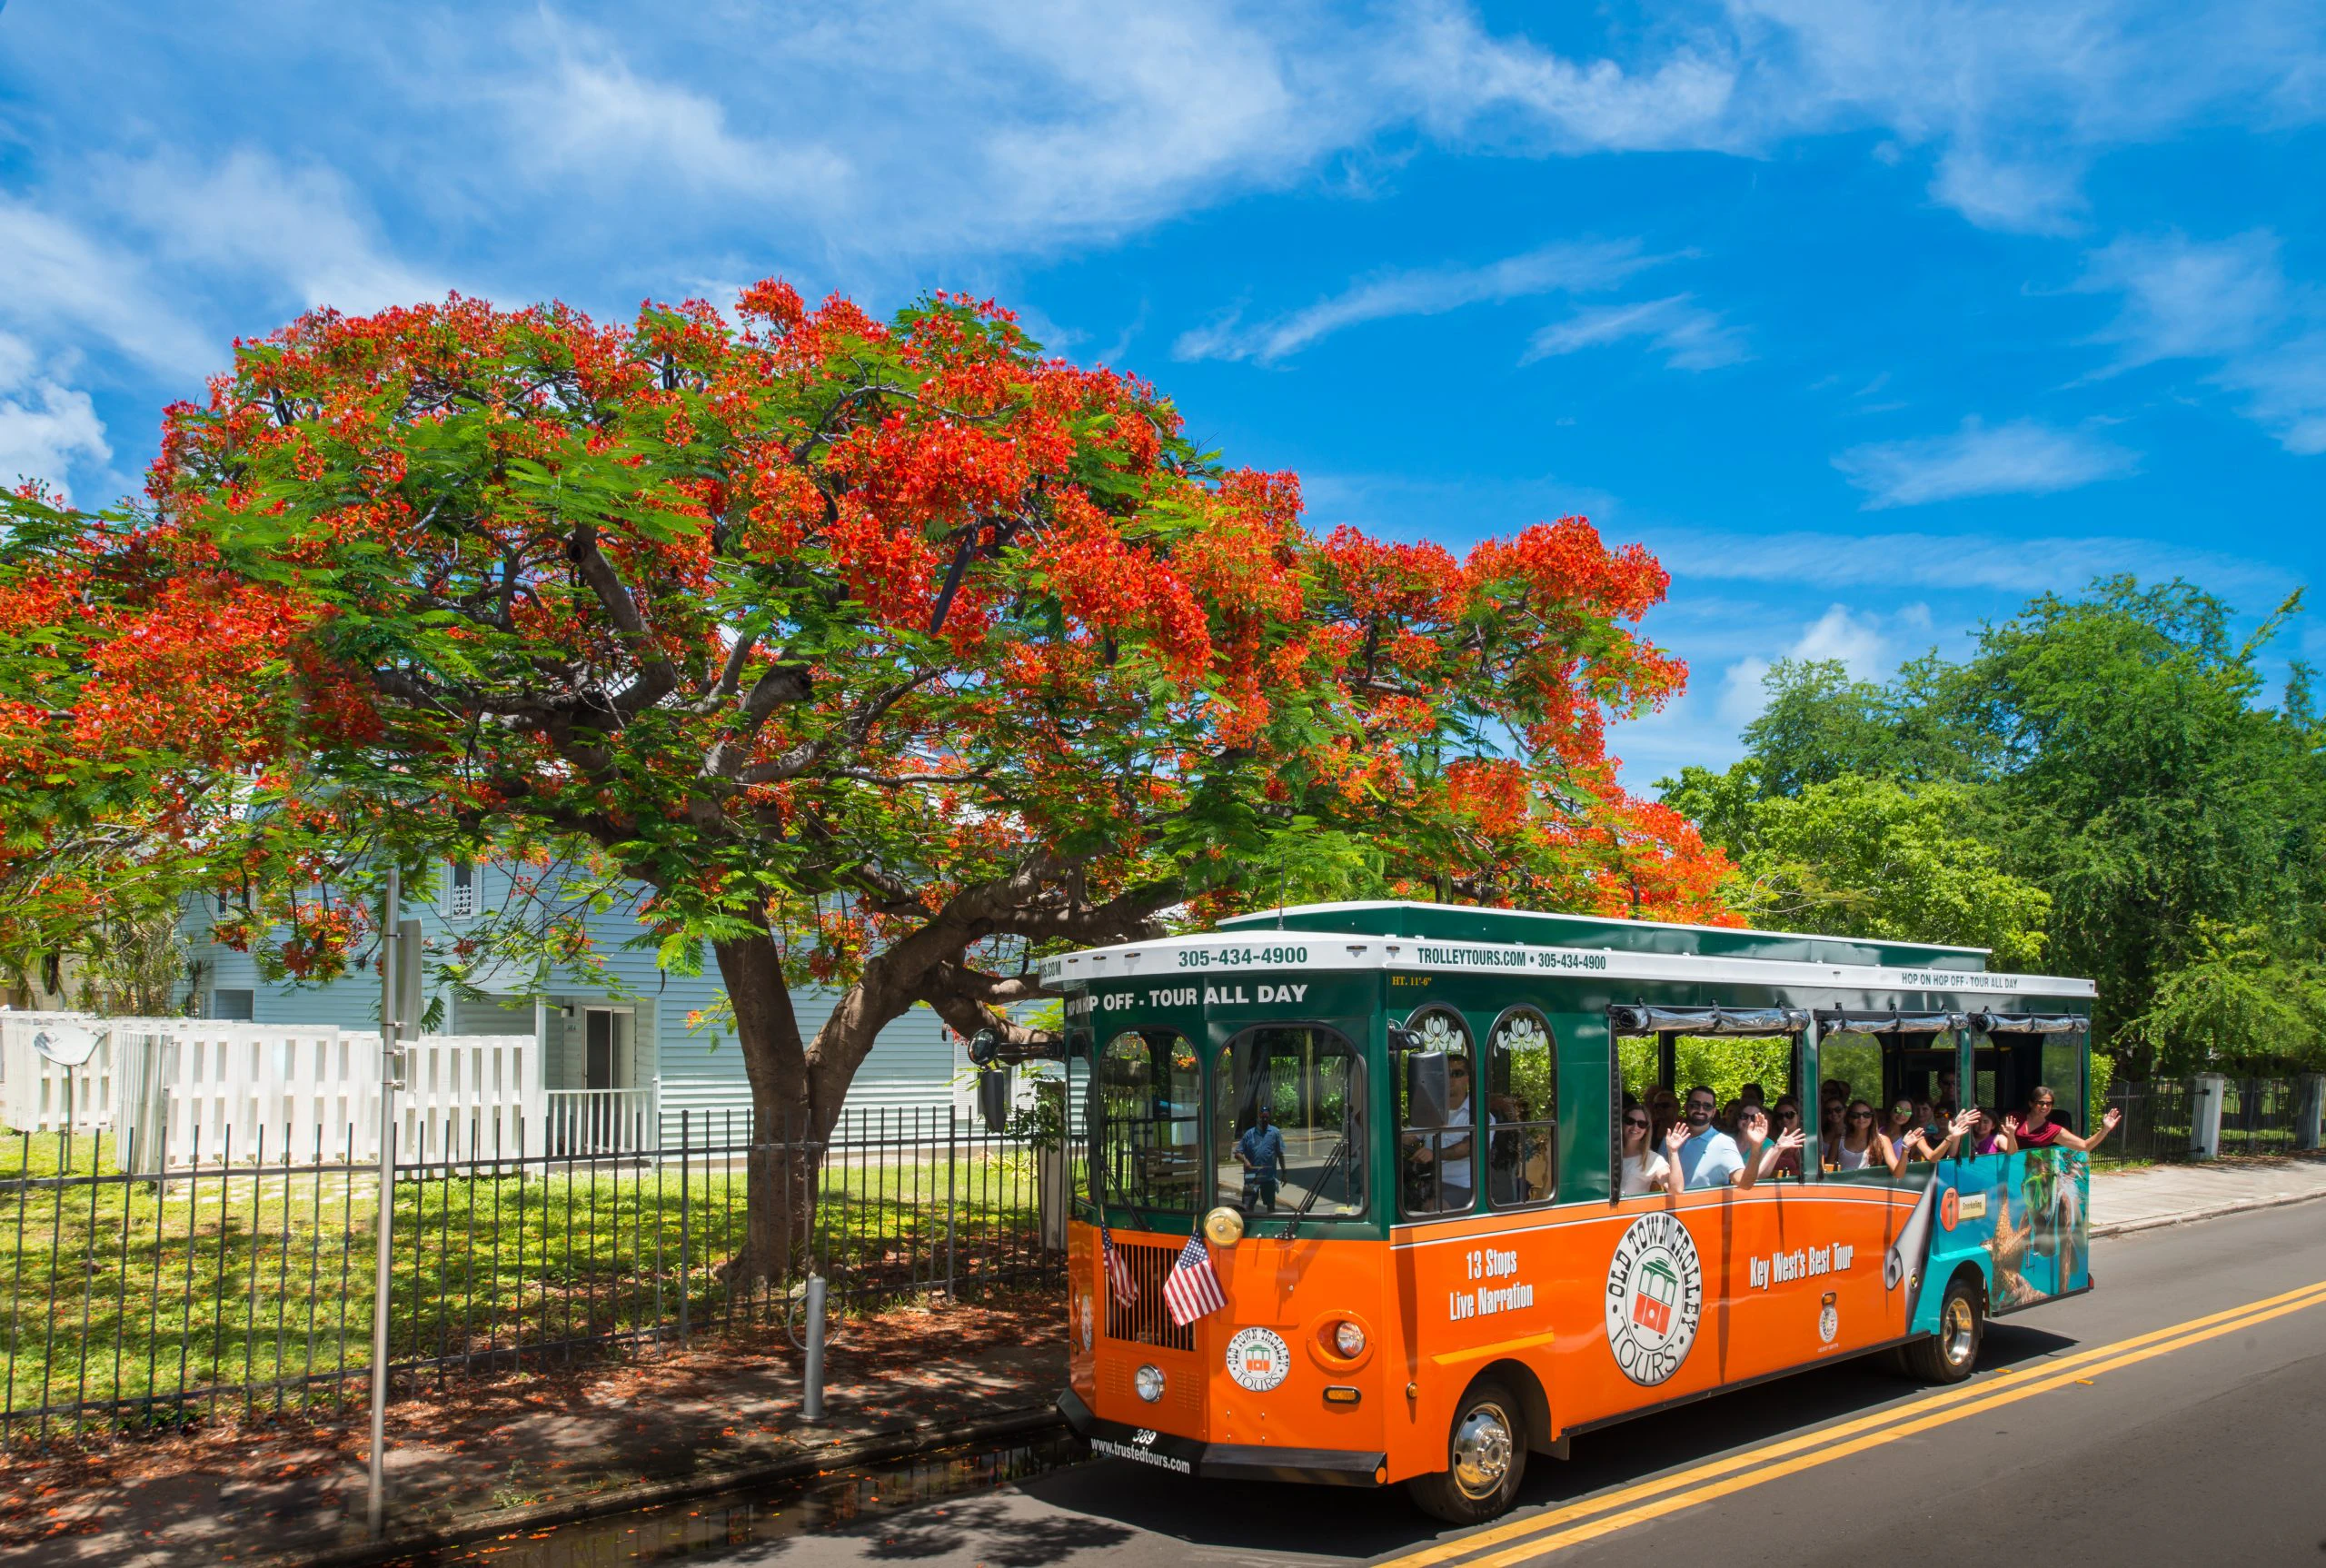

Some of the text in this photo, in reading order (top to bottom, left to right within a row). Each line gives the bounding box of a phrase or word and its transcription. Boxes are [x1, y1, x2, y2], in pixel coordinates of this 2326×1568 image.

[1178, 947, 1308, 967] 305-434-4900
[1417, 948, 1606, 970] TROLLEYTOURS.COM 305-434-4900
[1392, 976, 1408, 987] HT.
[1902, 972, 1918, 985] HOP
[1920, 974, 1932, 986] ON
[1933, 975, 1950, 987] HOP
[1951, 976, 1964, 987] OFF
[1970, 977, 1989, 987] TOUR
[1991, 978, 2003, 988] ALL
[2004, 978, 2018, 989] DAY
[1103, 993, 1135, 1011] OFF
[1148, 987, 1198, 1007] TOUR
[1203, 986, 1249, 1005] ALL
[1257, 984, 1308, 1003] DAY
[1947, 1199, 1953, 1226] 1
[1466, 1248, 1518, 1281] 13 Stops
[1608, 1215, 1701, 1335] OLD TOWN TROLLEY
[1750, 1242, 1854, 1291] Key West's Best Tour
[1450, 1281, 1534, 1322] Live Narration
[1228, 1328, 1289, 1367] OLD TOWN TROLLEY
[1611, 1315, 1678, 1384] TOURS
[1237, 1370, 1282, 1392] TOURS
[1132, 1428, 1158, 1445] 389
[1090, 1438, 1190, 1474] www.trustedtours.com
